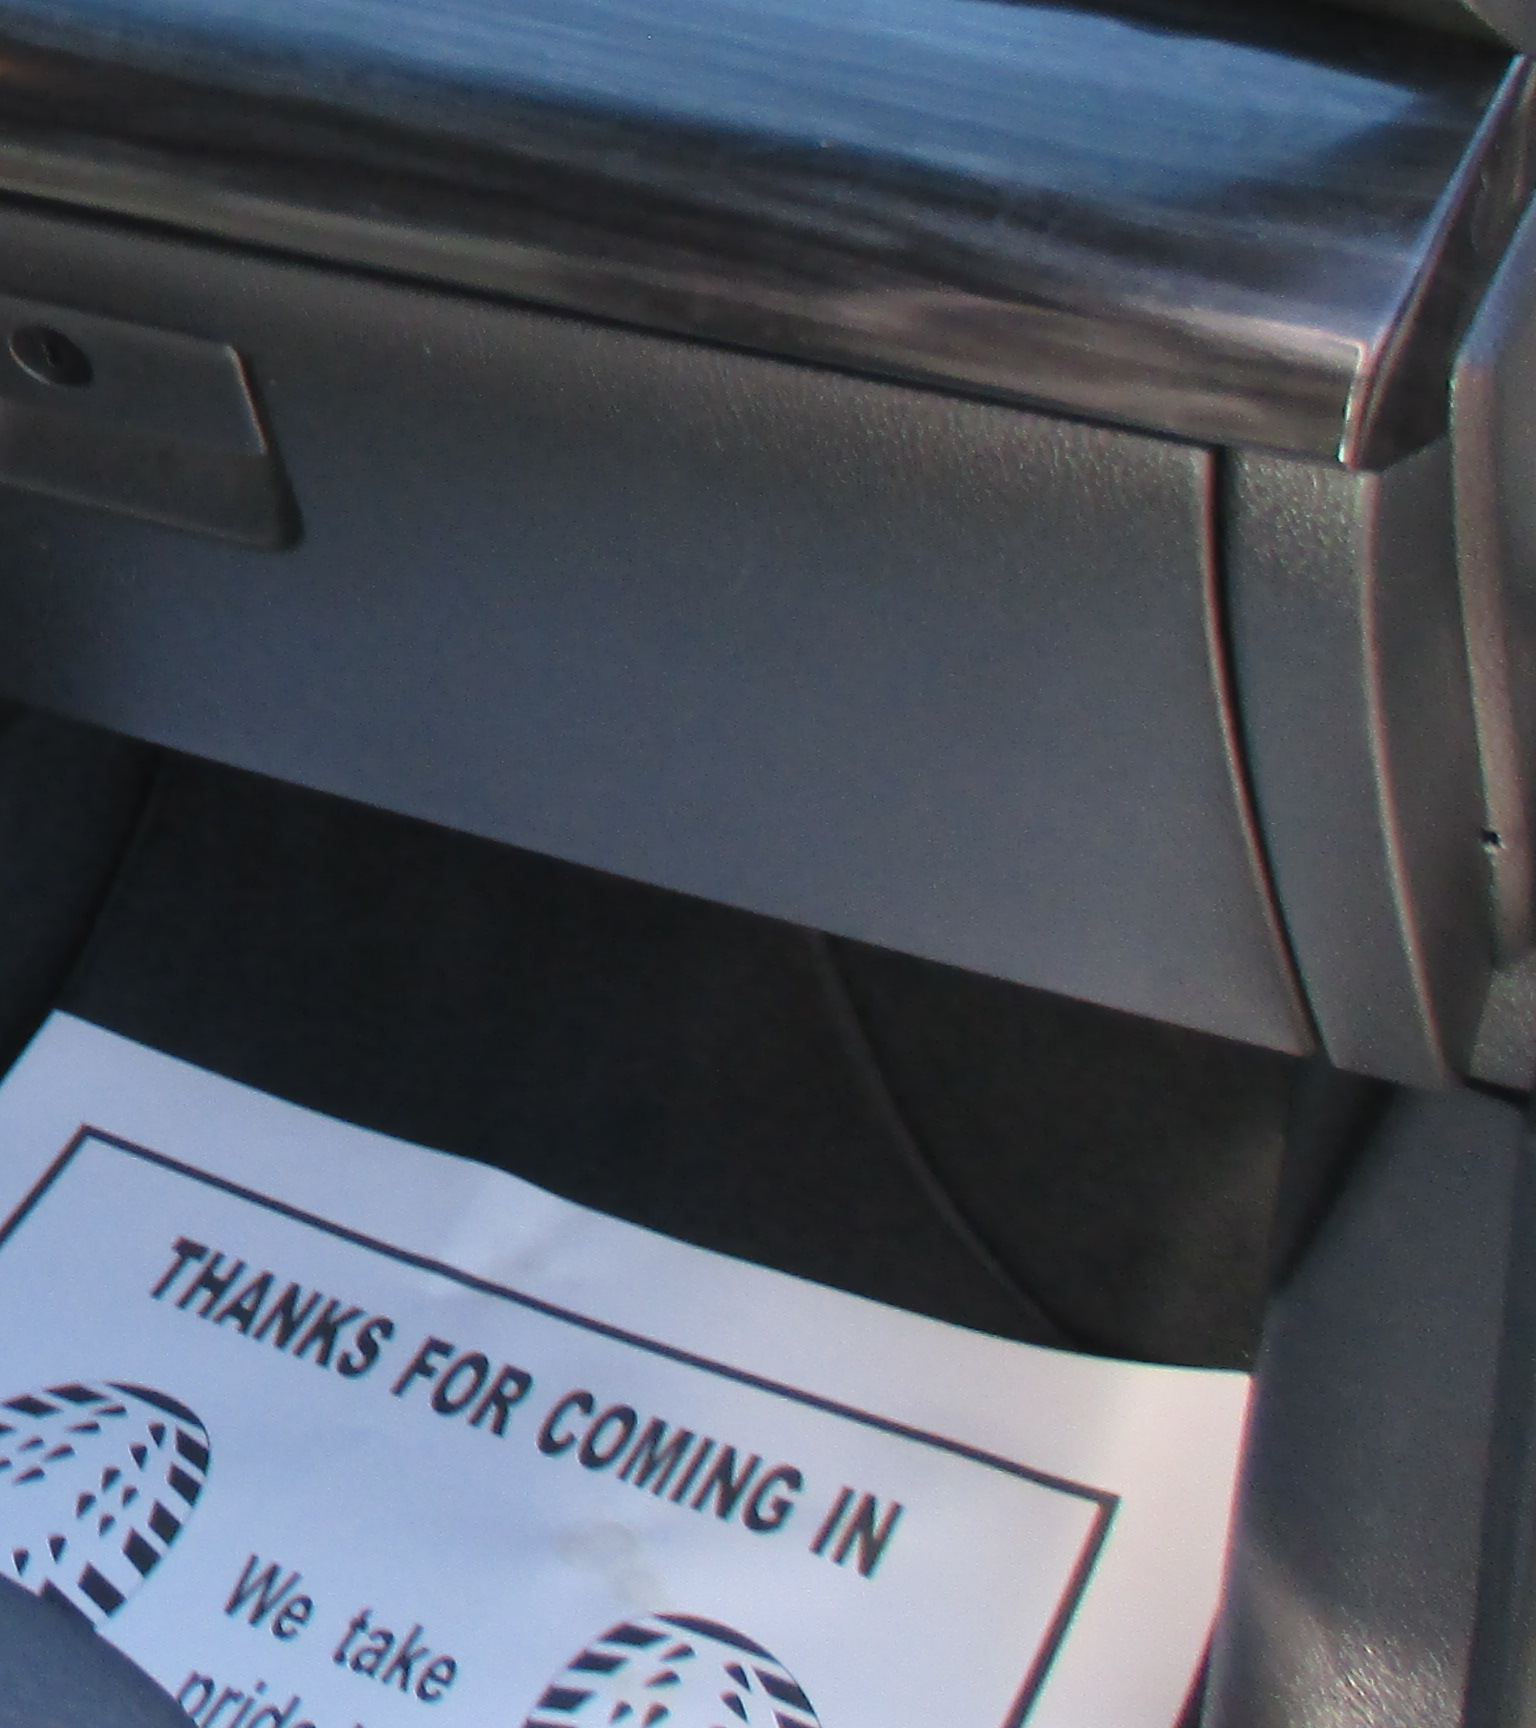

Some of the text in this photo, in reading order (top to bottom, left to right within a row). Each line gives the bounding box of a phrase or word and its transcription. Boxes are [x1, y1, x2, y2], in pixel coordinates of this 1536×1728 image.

[150, 1236, 903, 1579] THANKS FOR COMING IN
[223, 1553, 457, 1702] We take
